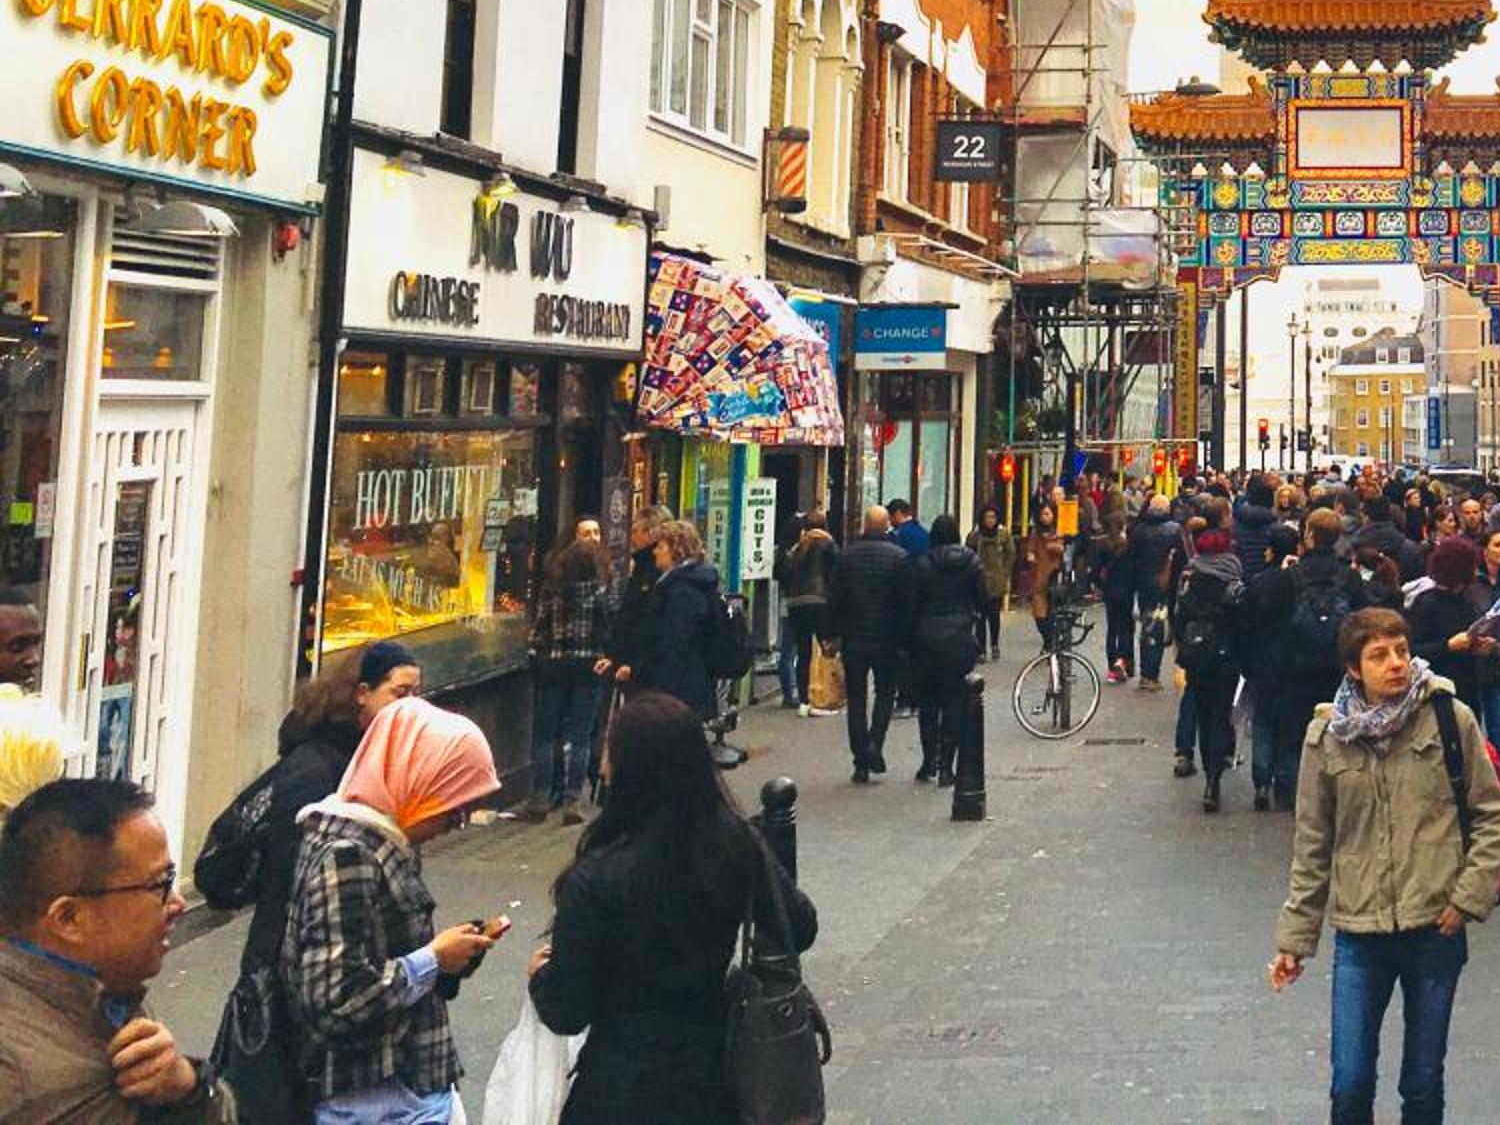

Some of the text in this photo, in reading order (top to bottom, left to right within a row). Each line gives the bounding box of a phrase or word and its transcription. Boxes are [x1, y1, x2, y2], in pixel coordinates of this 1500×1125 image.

[56, 59, 258, 178] CORNER
[953, 135, 985, 159] 22
[388, 270, 481, 327] CHINESE
[873, 326, 929, 340] CHANGE
[352, 464, 490, 530] HOT BUFFET
